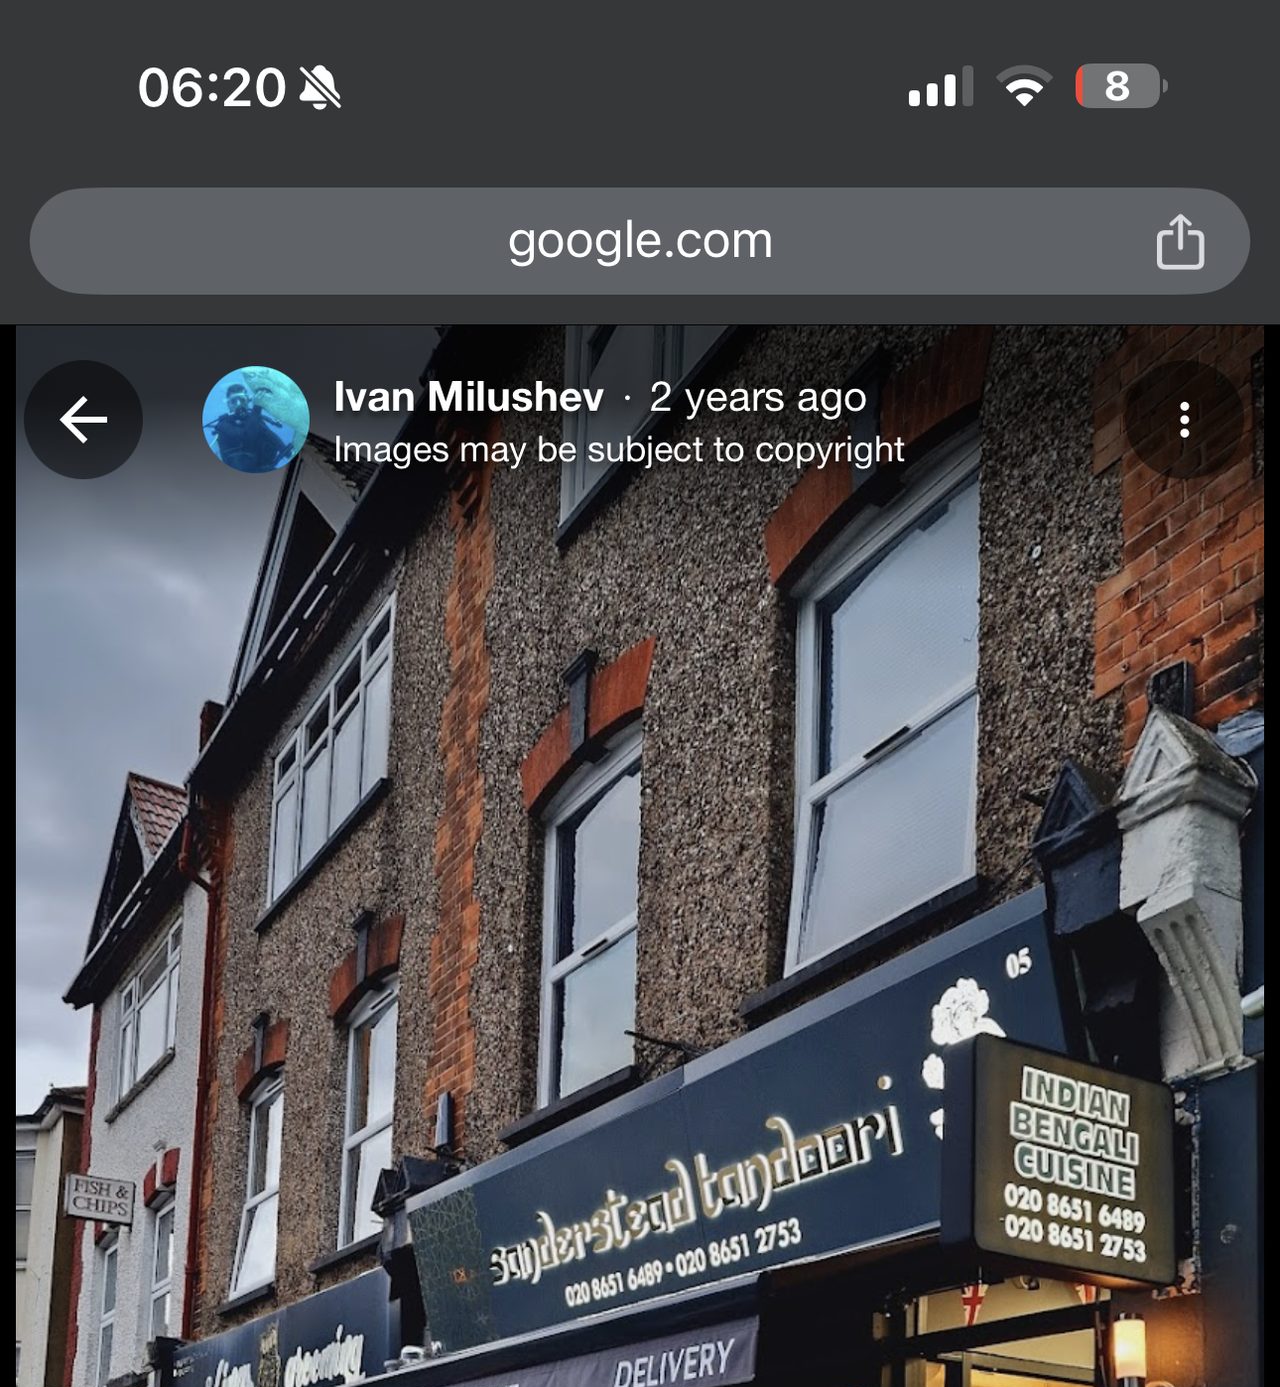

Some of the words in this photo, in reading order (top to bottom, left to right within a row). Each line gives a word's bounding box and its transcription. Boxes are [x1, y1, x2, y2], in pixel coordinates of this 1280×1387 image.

[1022, 1065, 1131, 1128] INDIAN
[1010, 1101, 1139, 1166] BENGALI
[74, 1178, 112, 1198] FISH
[115, 1185, 129, 1200] &
[489, 1158, 697, 1286] sanderstead
[694, 1074, 904, 1218] tandoori
[1014, 1142, 1136, 1201] CUISINE
[72, 1195, 129, 1217] CHIPS
[1004, 1182, 1042, 1212] 020
[1047, 1192, 1093, 1224] 8651
[1098, 1203, 1146, 1235] 6489
[564, 1281, 591, 1308] 020
[591, 1272, 625, 1301] 8651
[627, 1260, 663, 1291] 6489
[674, 1247, 706, 1277] 020
[708, 1233, 751, 1267] 8651
[754, 1217, 802, 1253] 2753
[1004, 1216, 1043, 1244] 020
[1048, 1224, 1094, 1253] 8651
[1099, 1234, 1147, 1263] 2753
